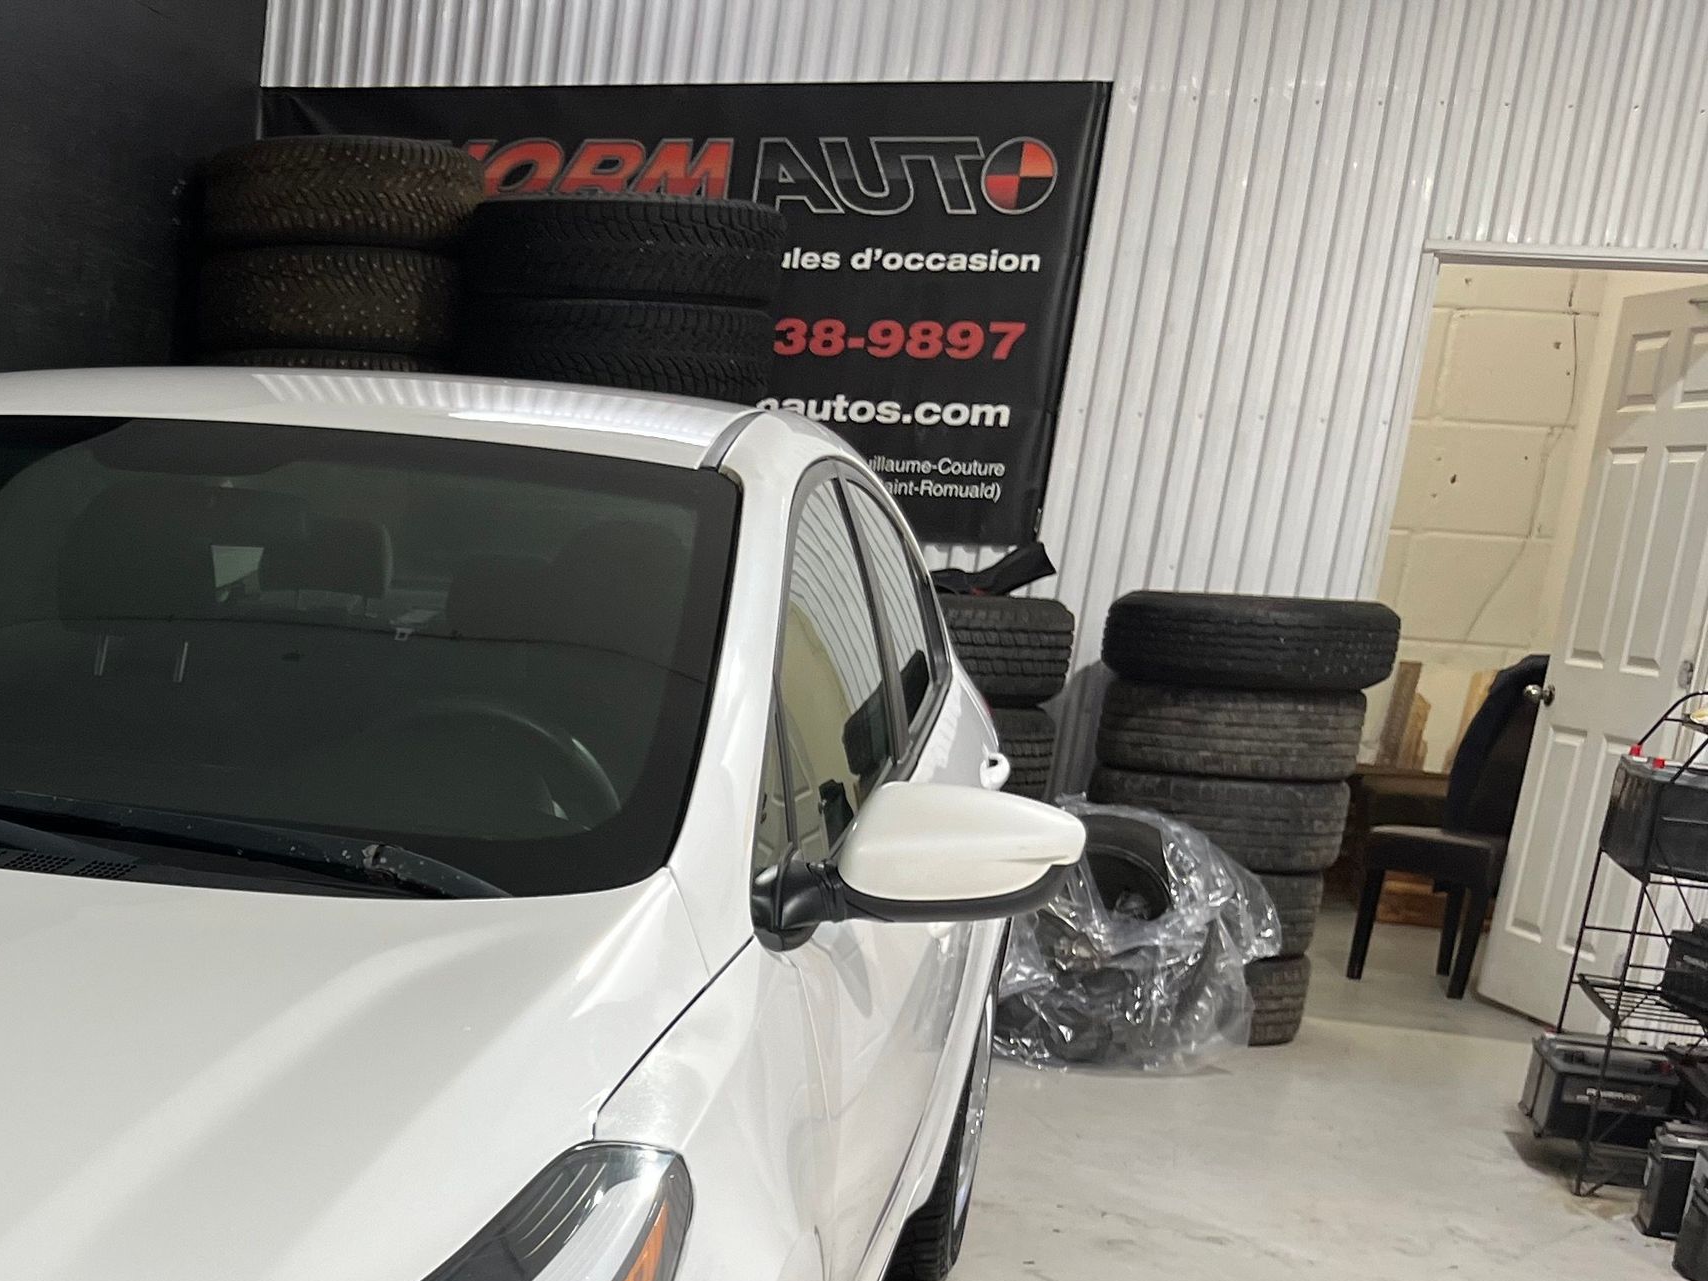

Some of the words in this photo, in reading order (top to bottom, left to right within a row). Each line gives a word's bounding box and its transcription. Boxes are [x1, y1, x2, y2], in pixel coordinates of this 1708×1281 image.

[468, 138, 734, 200] ORM
[850, 248, 1041, 273] d'occasion
[773, 318, 1027, 360] 38-9897
[880, 478, 1001, 503] aint-Romuald)
